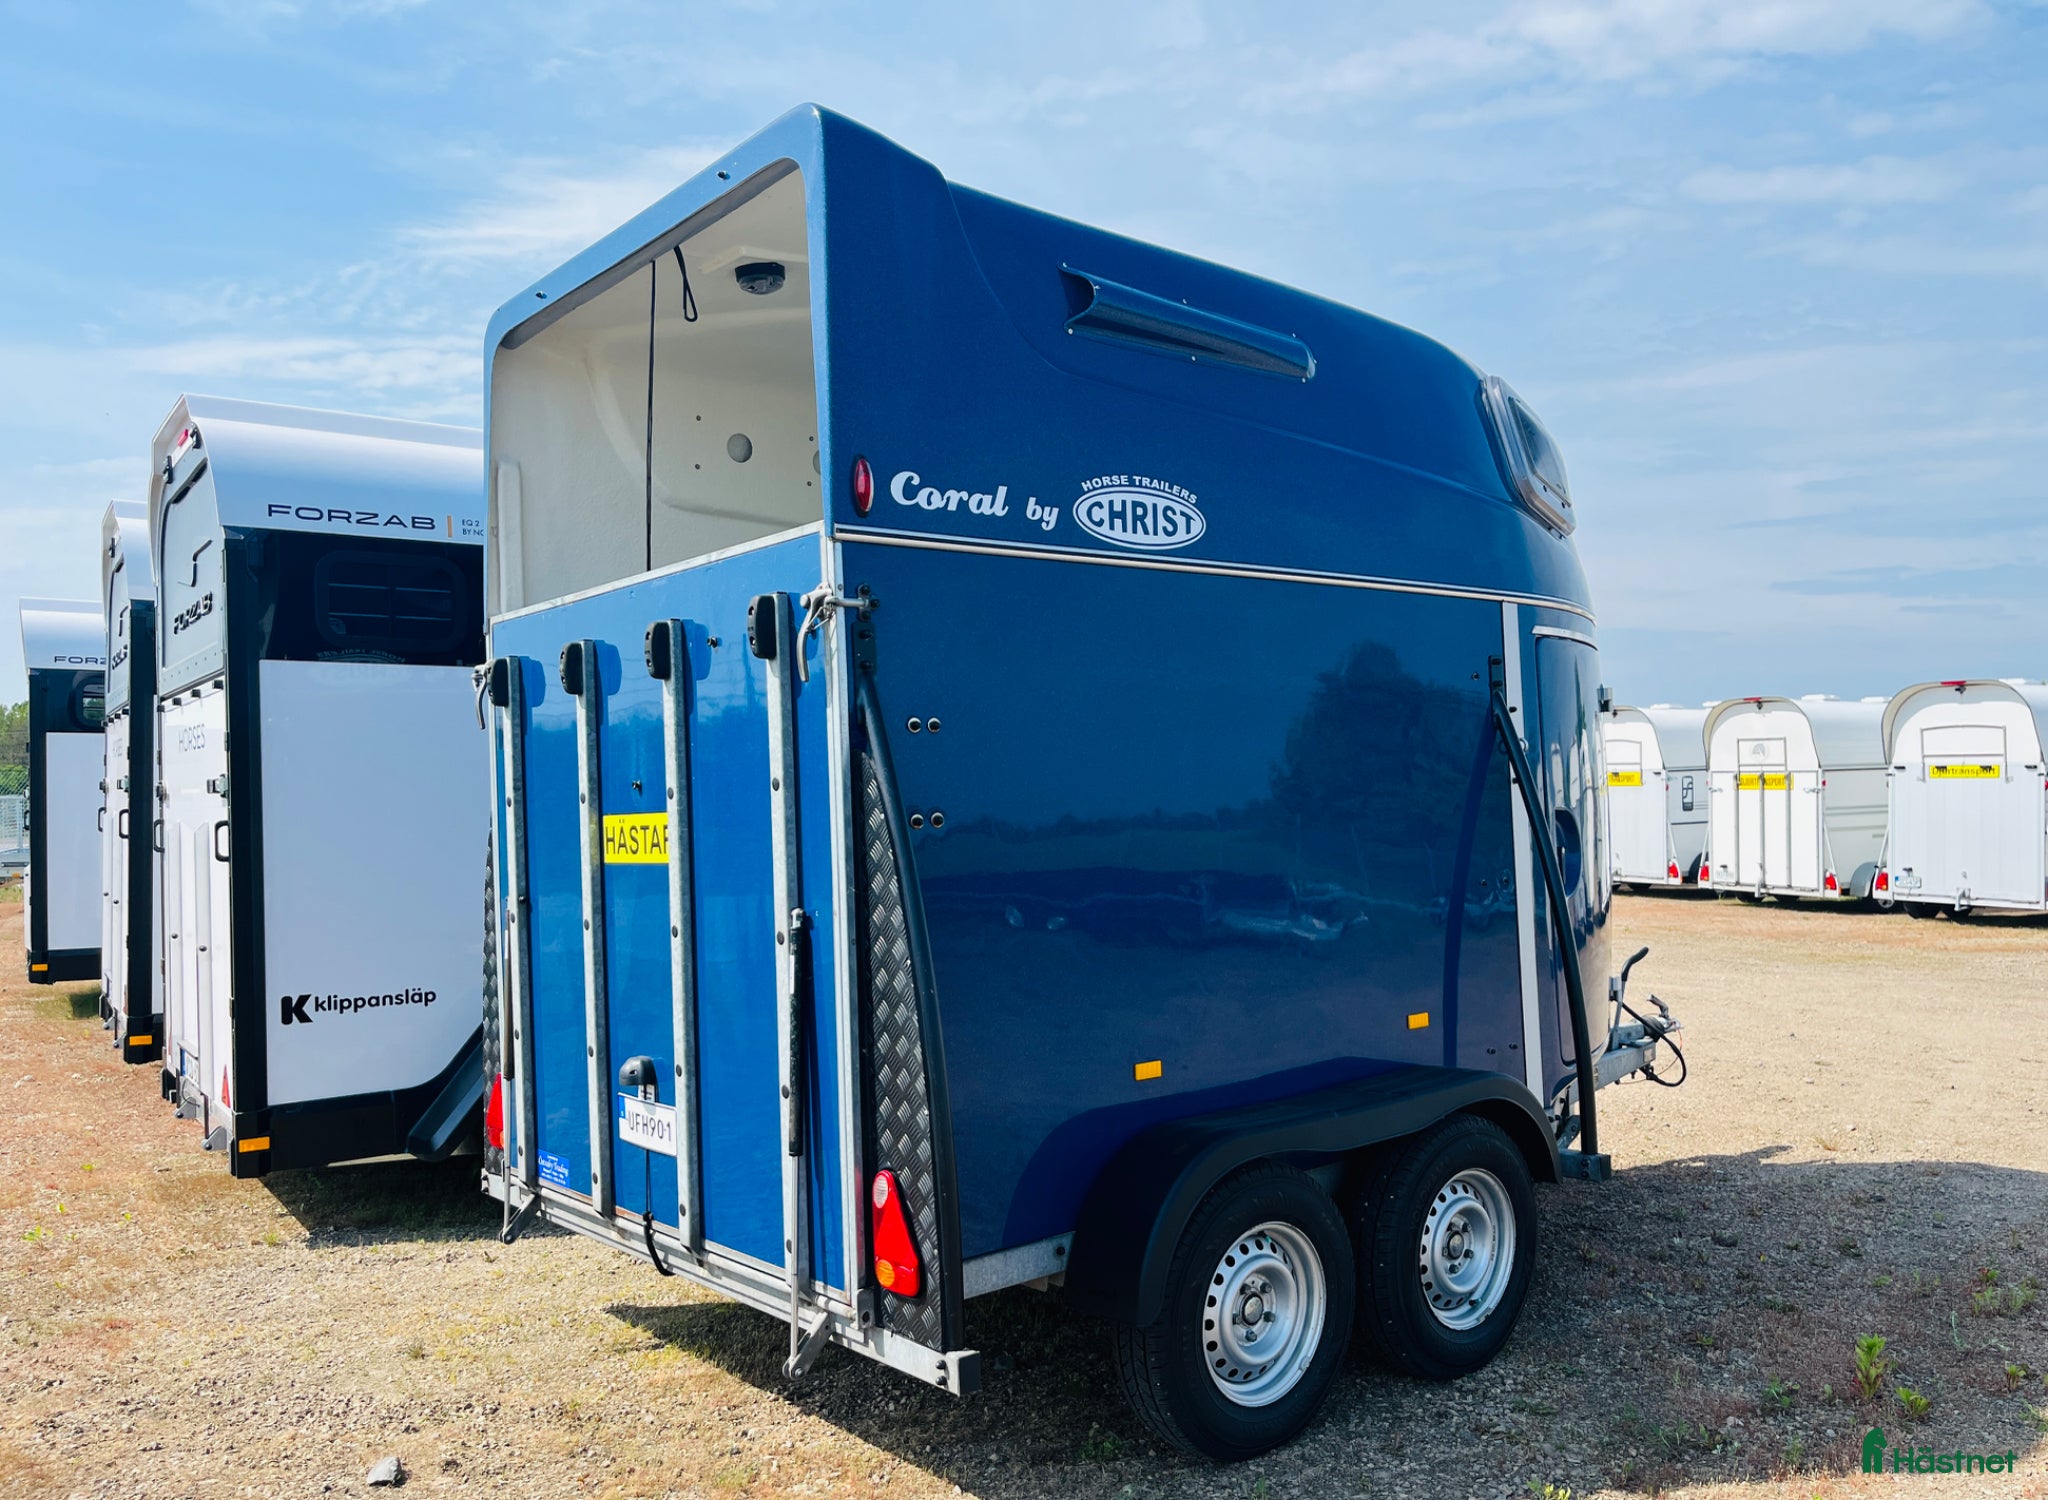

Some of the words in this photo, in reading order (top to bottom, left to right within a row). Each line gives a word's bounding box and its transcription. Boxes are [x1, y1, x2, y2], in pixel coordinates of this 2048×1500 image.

[890, 471, 1009, 517] Coral
[1025, 497, 1059, 531] by
[1081, 475, 1129, 492] HORSE
[1132, 475, 1198, 504] TRAILERS
[267, 504, 436, 530] FORZAB
[461, 519, 473, 527] EQ
[1086, 499, 1196, 537] CHRIST
[462, 528, 471, 536] BY
[314, 987, 437, 1014] klippansläp
